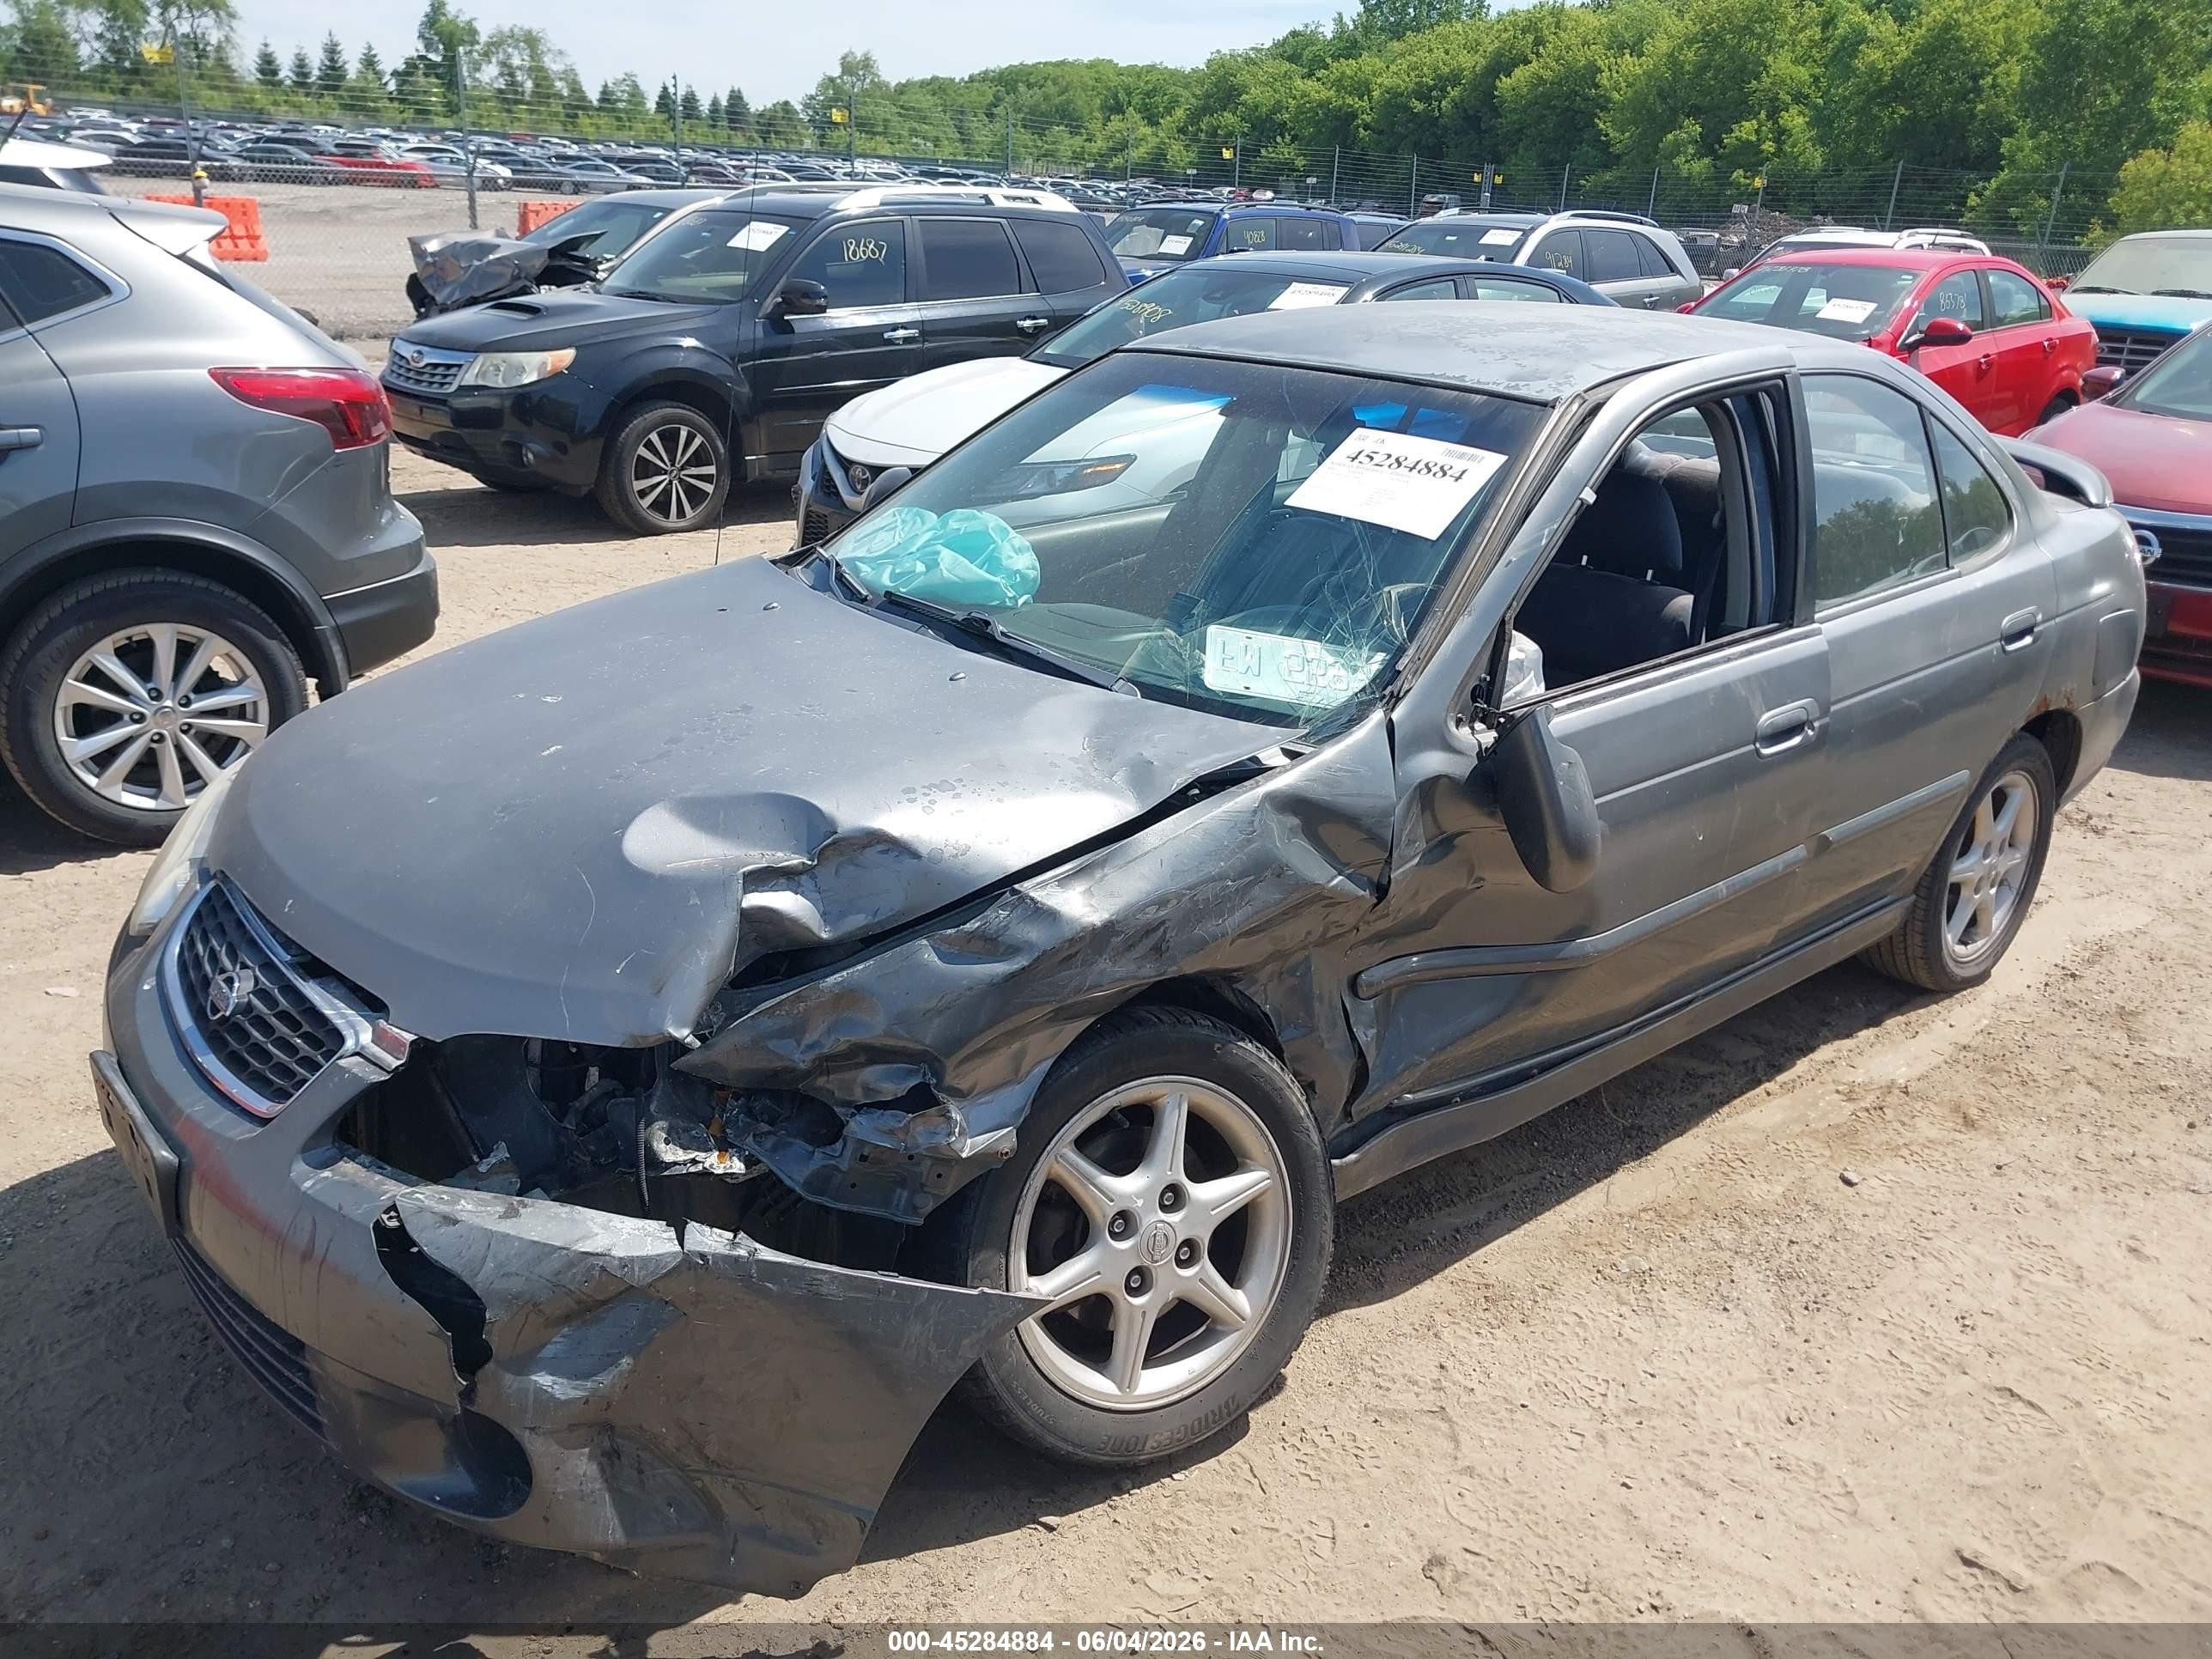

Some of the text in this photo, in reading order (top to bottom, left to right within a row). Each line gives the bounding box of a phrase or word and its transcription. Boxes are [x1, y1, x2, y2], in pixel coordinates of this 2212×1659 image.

[842, 237, 888, 266] 18687
[1545, 251, 1573, 270] 91284
[1346, 448, 1471, 483] 45284884
[1099, 1393, 1242, 1455] BRIDGESTONE
